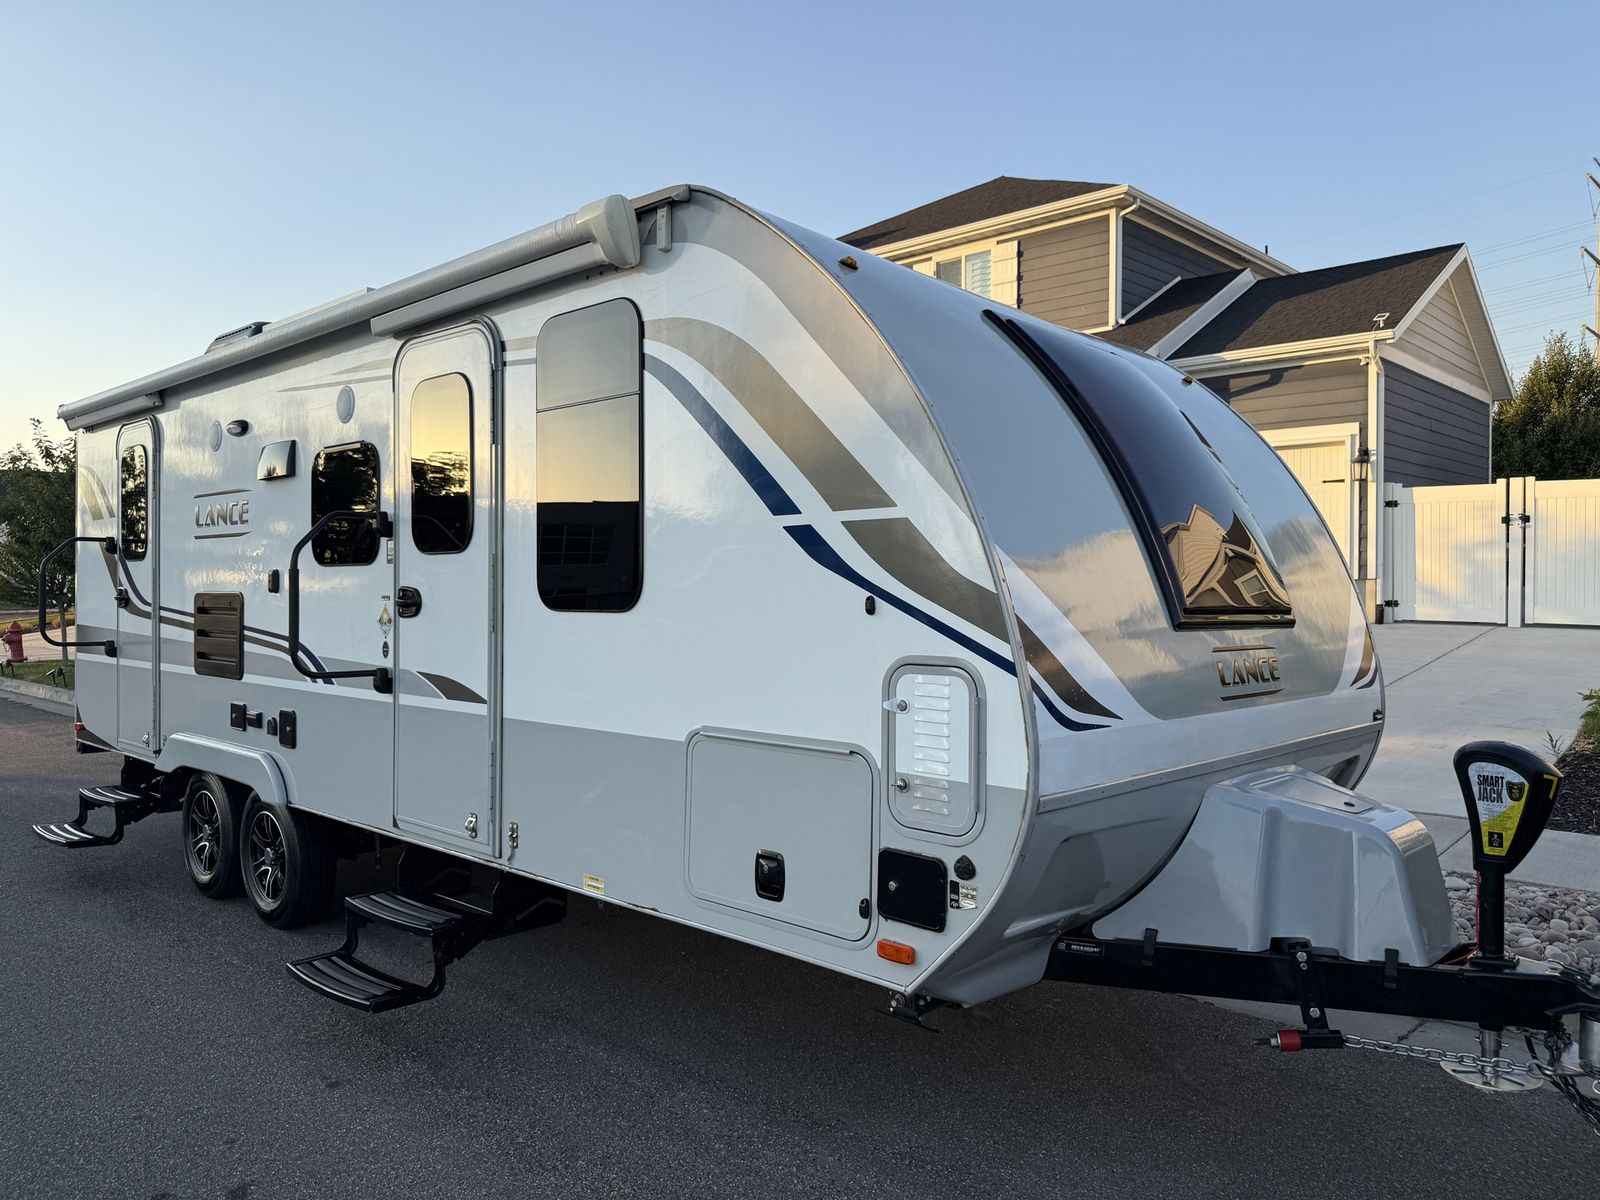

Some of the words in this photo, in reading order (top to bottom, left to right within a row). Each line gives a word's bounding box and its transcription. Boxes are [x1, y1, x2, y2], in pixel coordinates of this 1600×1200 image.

[195, 500, 249, 528] LANCE
[1216, 656, 1280, 688] LANCE
[1477, 773, 1504, 788] SMART
[1477, 786, 1503, 804] JACK
[960, 891, 977, 901] SIDE
